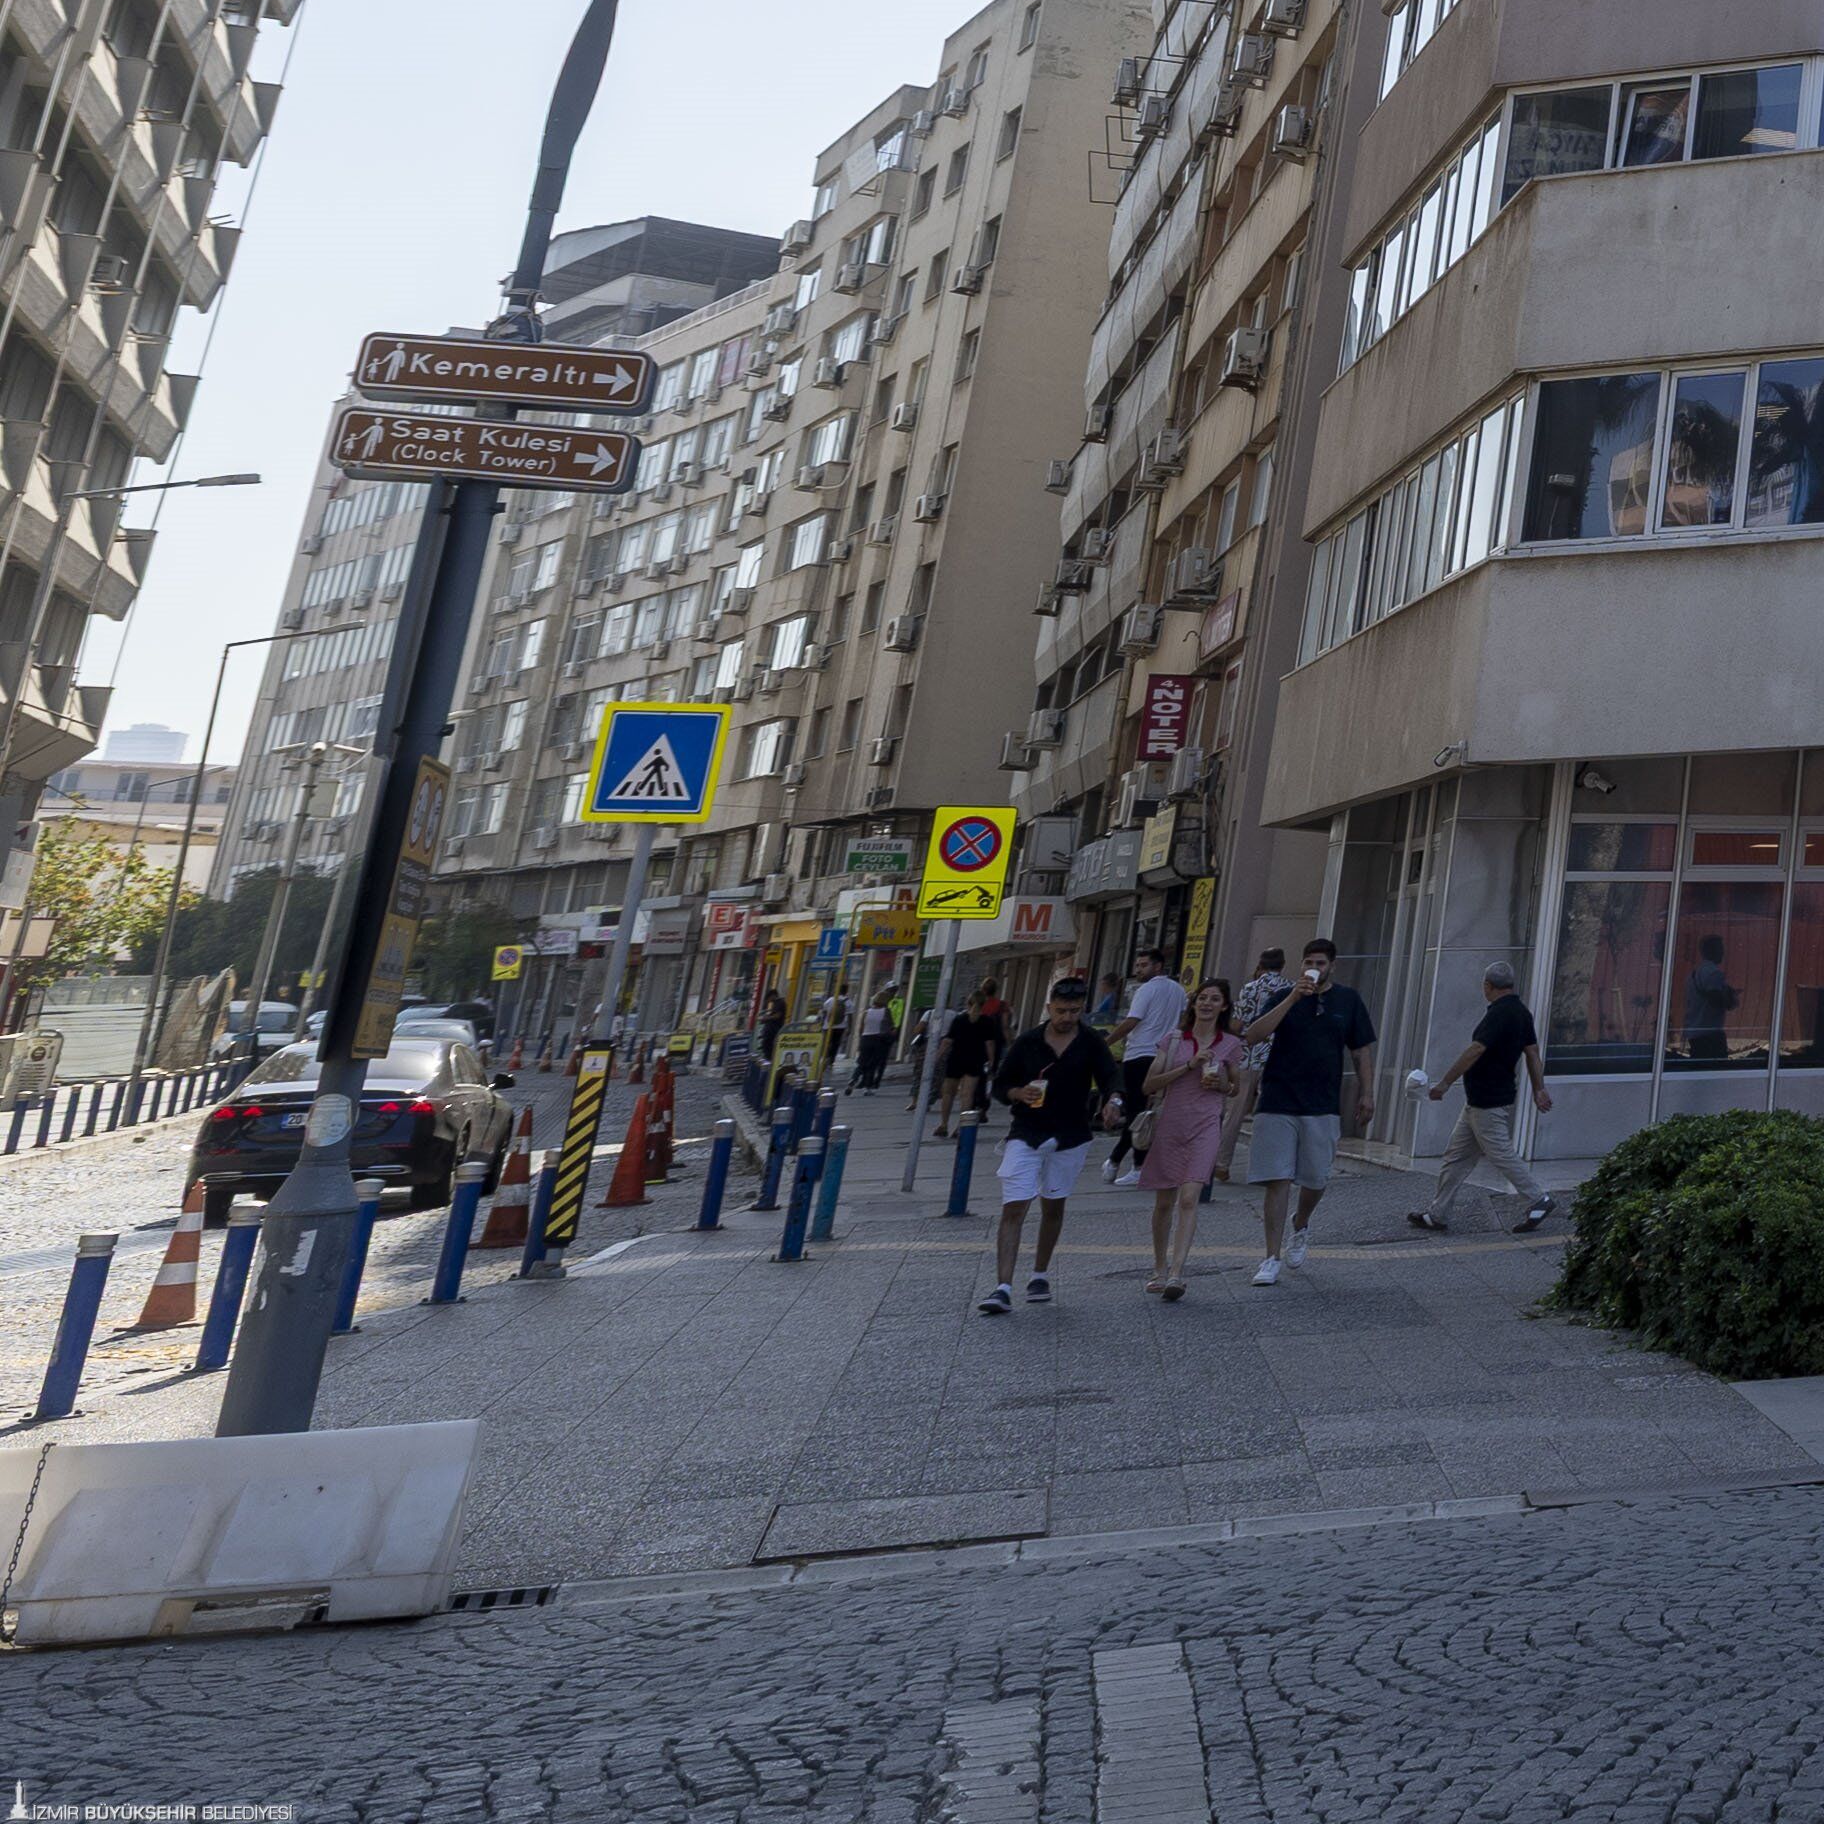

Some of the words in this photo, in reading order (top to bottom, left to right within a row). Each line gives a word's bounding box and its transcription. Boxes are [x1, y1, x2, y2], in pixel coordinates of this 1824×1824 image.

[408, 352, 587, 385] Kemeraltı
[390, 420, 464, 444] Saat
[478, 428, 571, 453] Kulesi
[391, 443, 467, 464] (Clock
[479, 450, 557, 475] Tower)
[1160, 679, 1181, 688] 4.
[1146, 688, 1184, 754] NOTER
[862, 855, 893, 863] FOTO
[1014, 903, 1053, 932] M
[287, 1113, 301, 1125] 20
